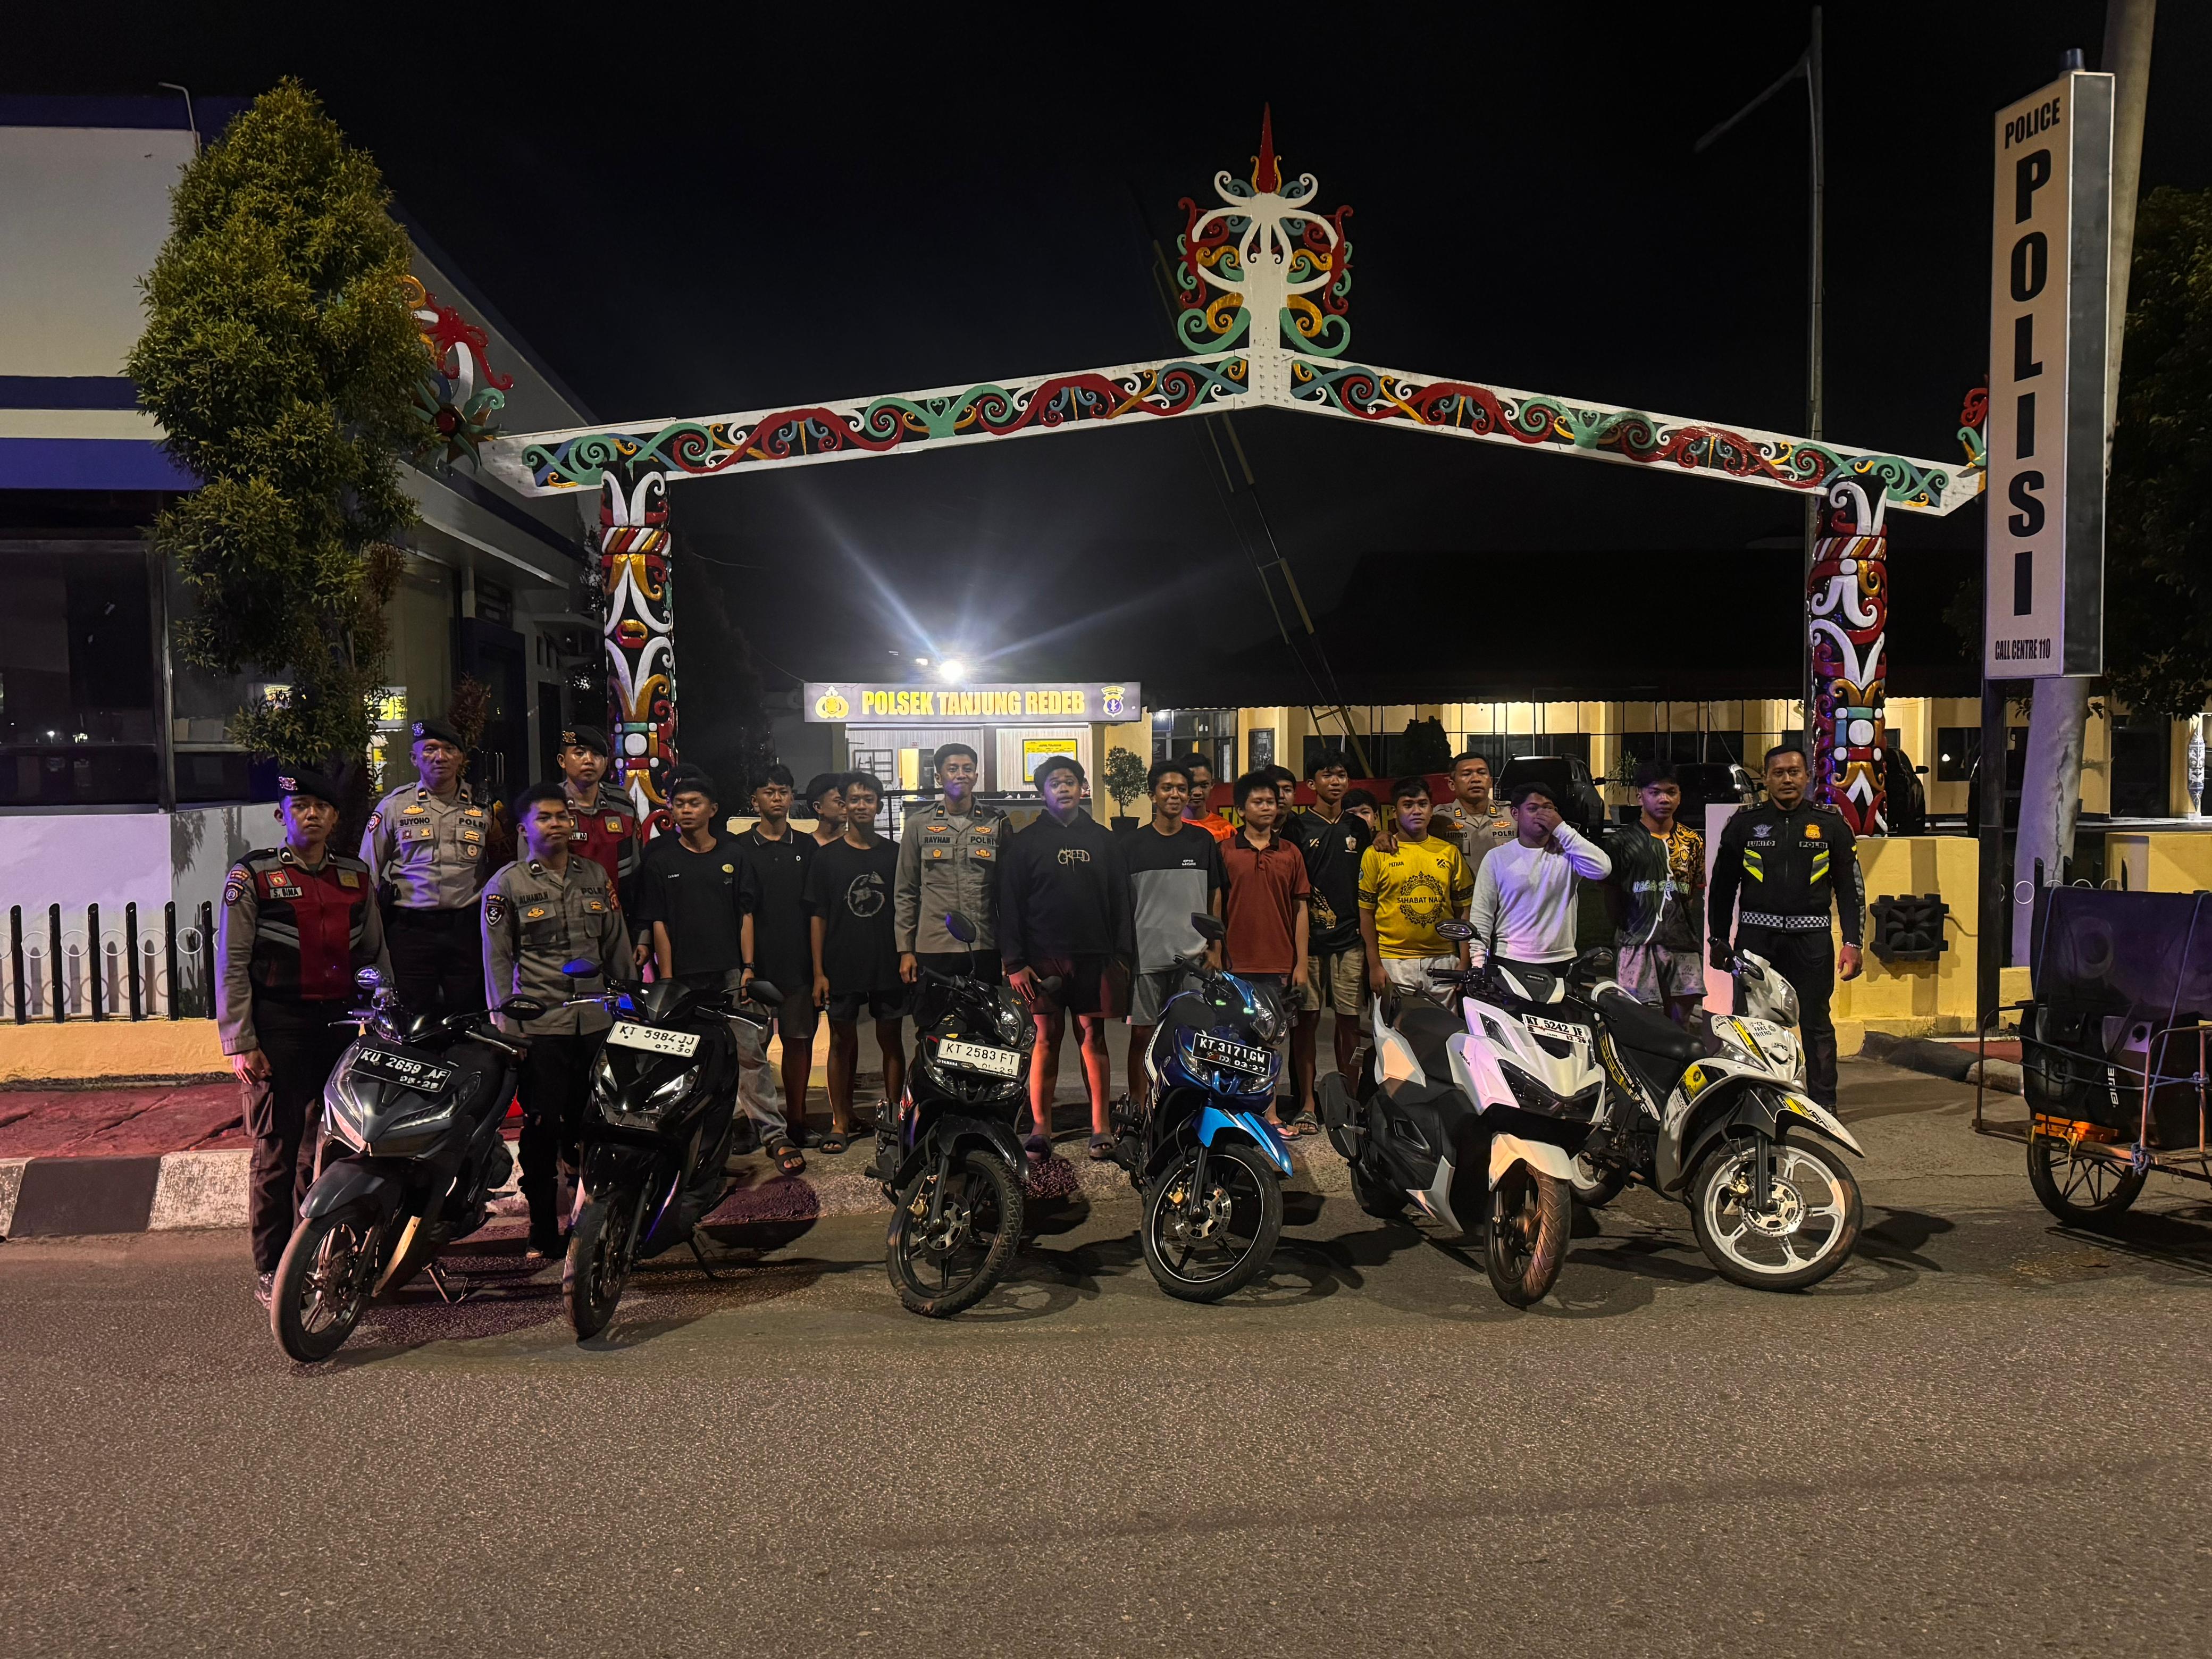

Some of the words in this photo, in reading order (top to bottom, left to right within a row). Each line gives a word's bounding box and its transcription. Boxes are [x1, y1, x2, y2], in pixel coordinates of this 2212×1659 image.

[2005, 97, 2060, 149] POLICE
[2008, 149, 2051, 616] POLISI
[1995, 640, 2010, 660] CALL
[2012, 639, 2037, 659] CENTRE
[2039, 638, 2050, 659] 110
[862, 691, 934, 715] POLSEK
[936, 691, 1021, 715] TANJUNG
[1025, 691, 1085, 715] REDEB
[459, 818, 486, 829] POLRI
[970, 836, 995, 845] POLRI
[619, 1025, 637, 1035] KT
[644, 1030, 676, 1042] 5984
[678, 1036, 694, 1045] JJ
[1526, 1016, 1538, 1025] KT
[1572, 1026, 1582, 1036] JF
[946, 1043, 961, 1053] KT
[966, 1046, 996, 1060] 2583
[1000, 1053, 1015, 1065] FT
[1200, 1038, 1215, 1049] KT
[1218, 1043, 1247, 1058] 3171
[1250, 1051, 1265, 1063] GW
[361, 1050, 381, 1062] KU
[386, 1057, 422, 1074] 2659
[428, 1069, 447, 1079] AF
